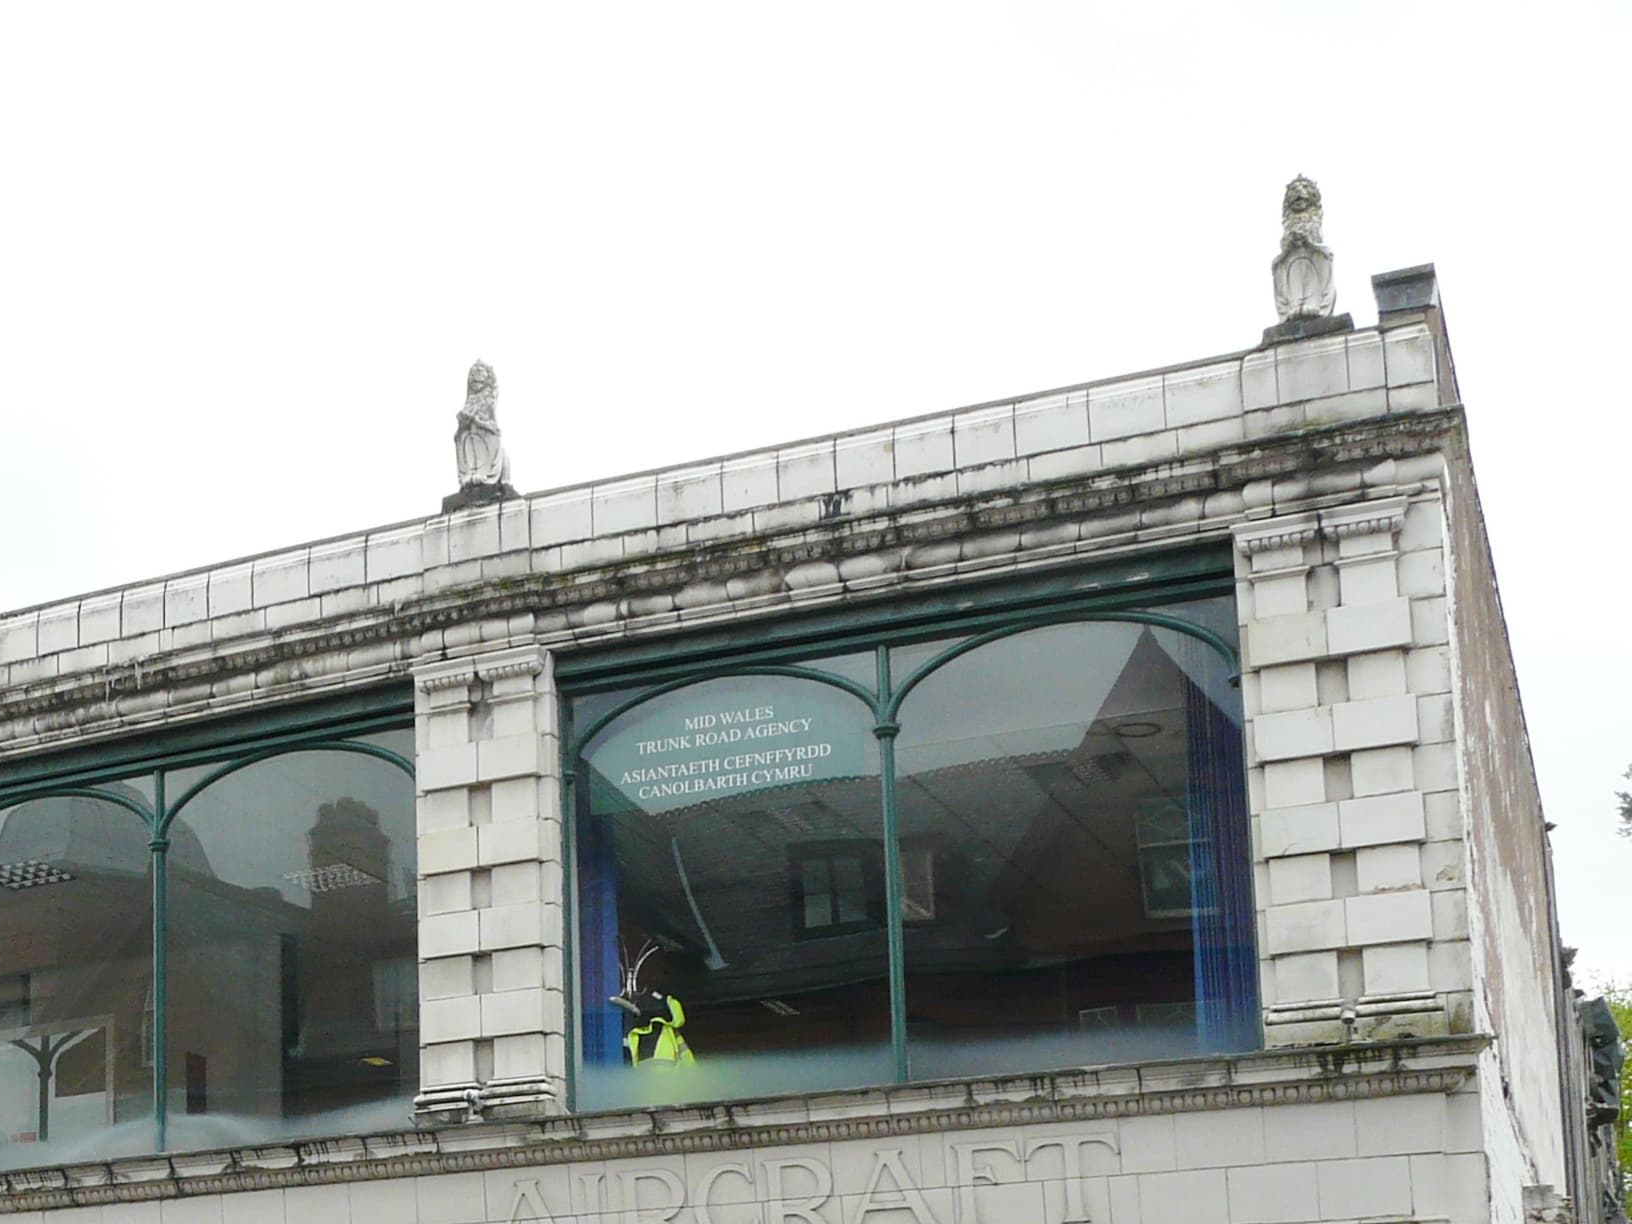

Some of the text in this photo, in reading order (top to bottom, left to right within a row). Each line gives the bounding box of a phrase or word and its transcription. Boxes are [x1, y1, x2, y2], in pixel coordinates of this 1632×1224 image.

[636, 717, 813, 756] TRUNK ROAD AGENCY
[684, 705, 775, 731] MID WALES
[620, 743, 832, 786] ASIANTAETH CEFNFFYRDD
[638, 763, 813, 800] CANOLBARTH CYMRU
